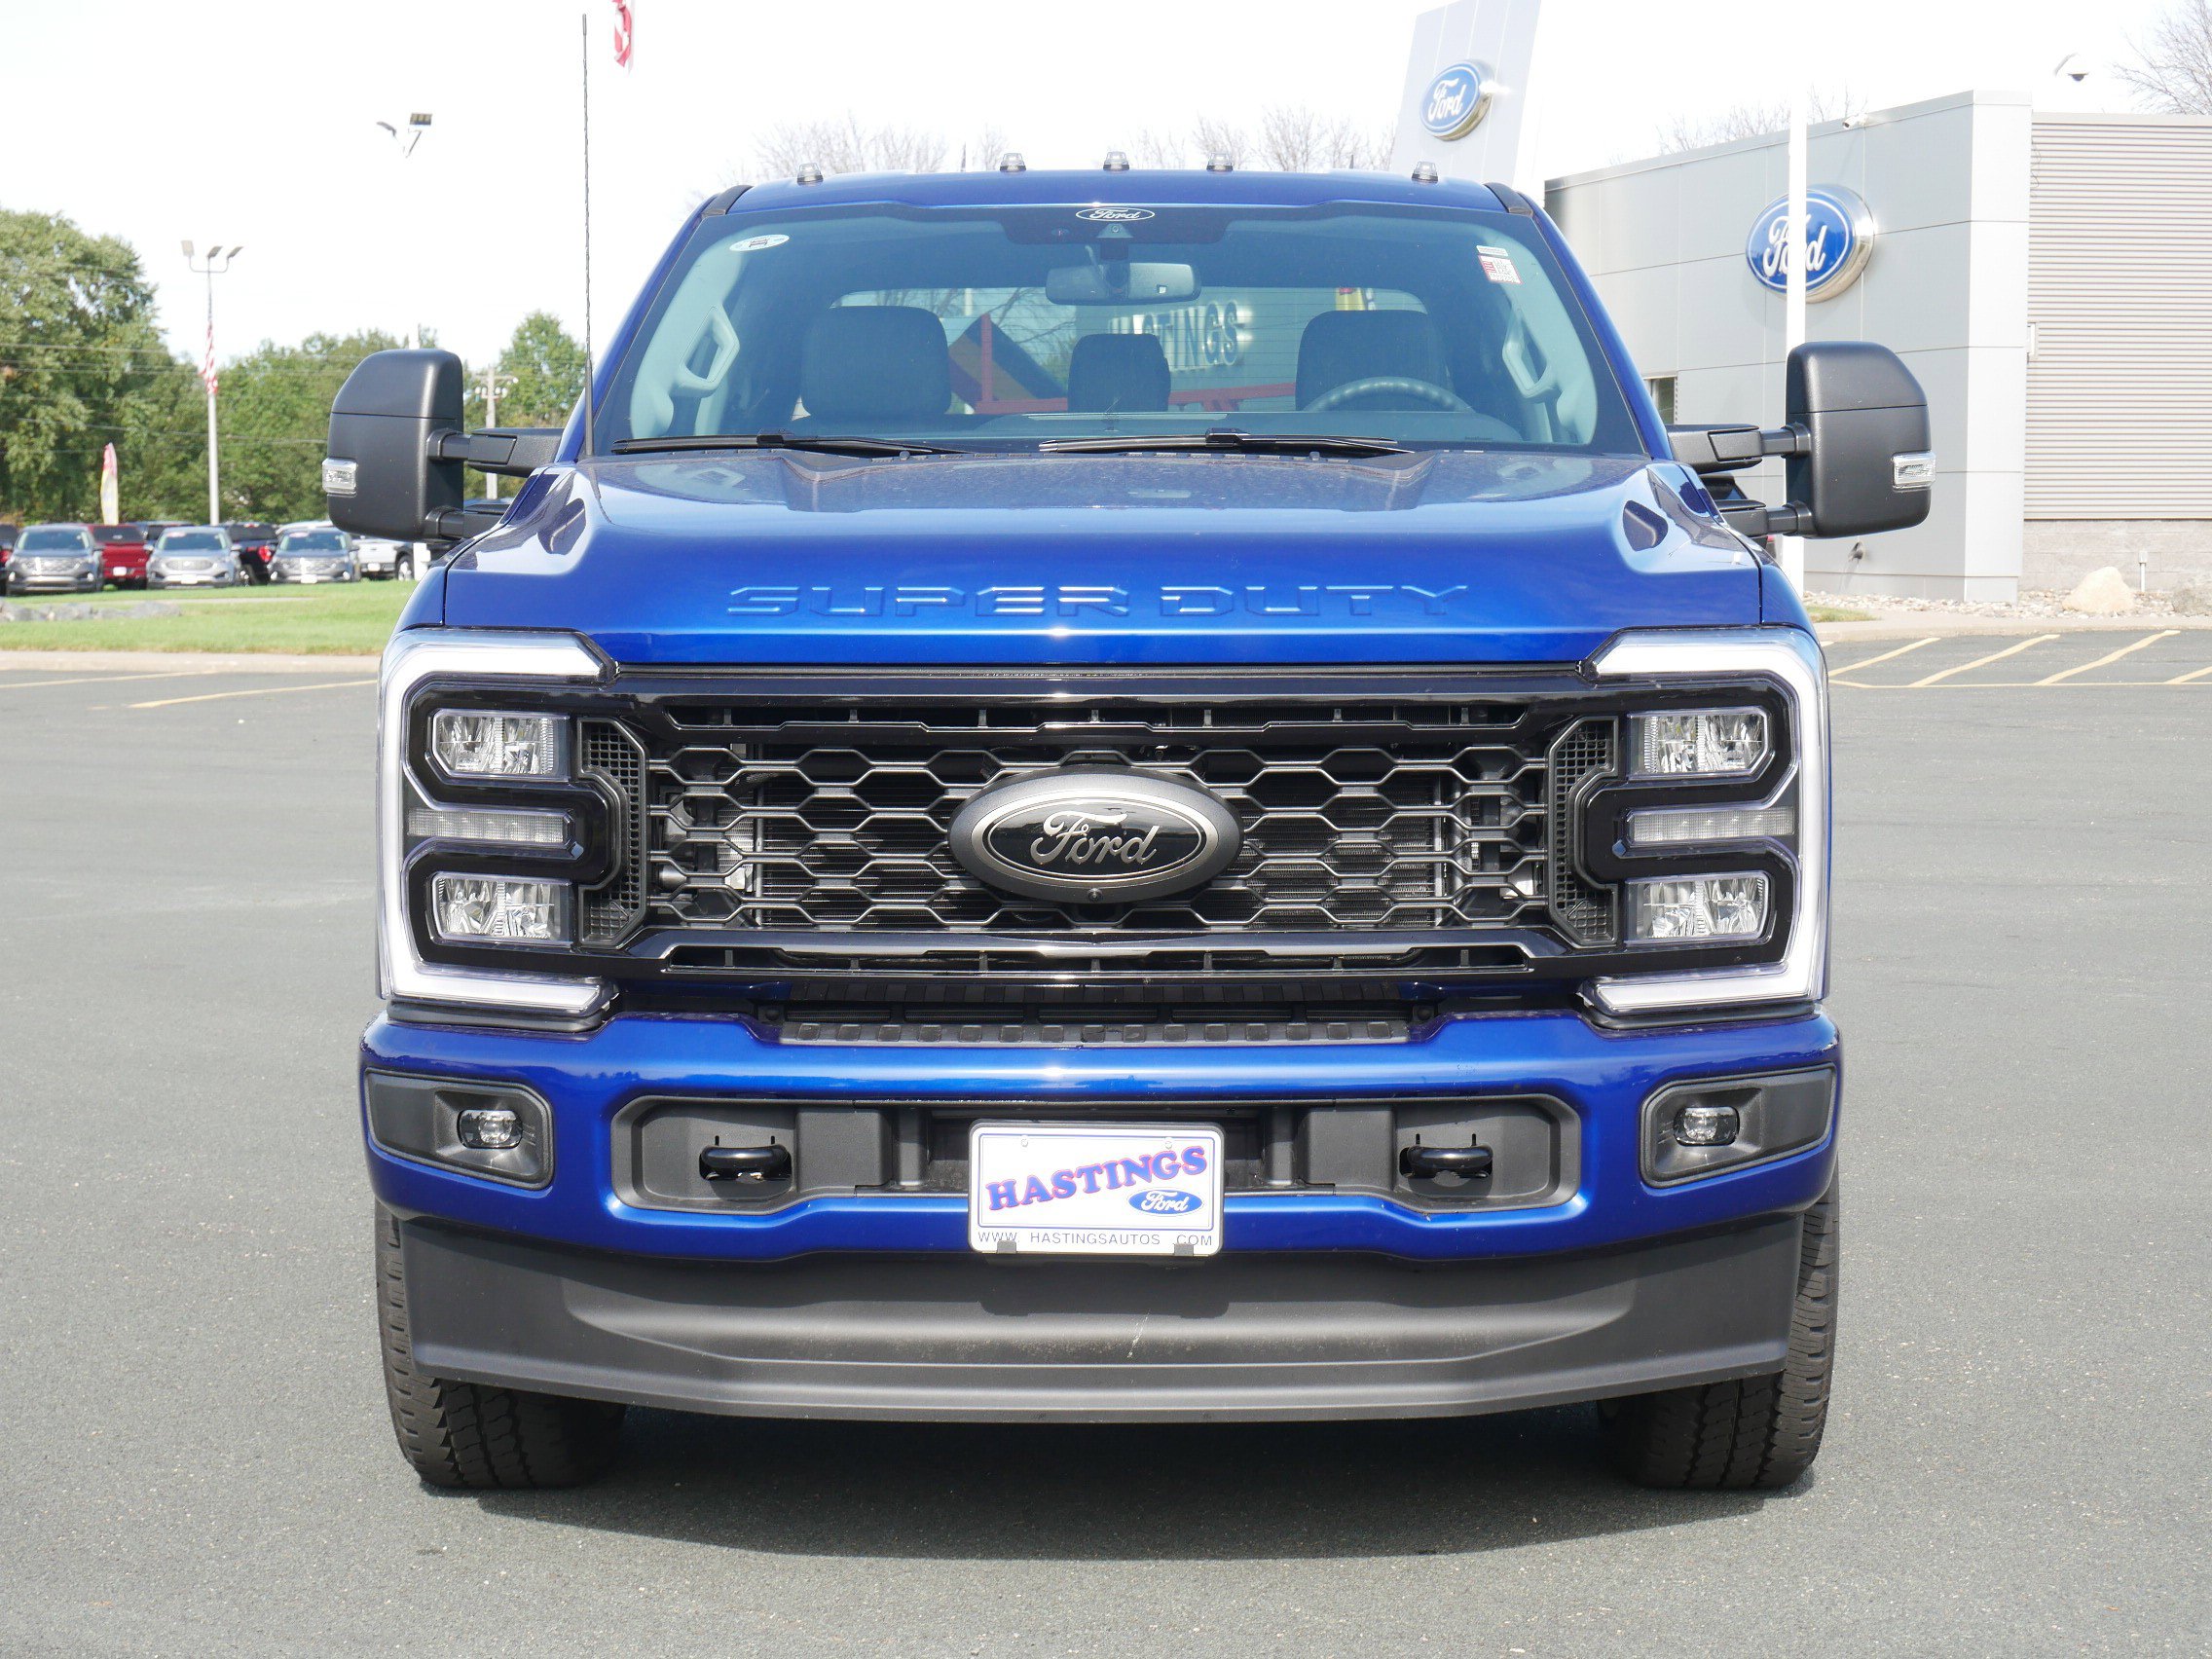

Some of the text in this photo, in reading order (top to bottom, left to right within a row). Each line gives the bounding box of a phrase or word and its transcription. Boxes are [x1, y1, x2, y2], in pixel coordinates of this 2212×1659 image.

[1427, 78, 1467, 122] Ford
[1089, 206, 1141, 219] Ford
[727, 585, 1468, 616] SUPER DUTY
[1030, 811, 1161, 865] Ford
[985, 1145, 1208, 1211] HASTINGS
[1141, 1190, 1190, 1211] Ford
[1030, 1232, 1161, 1245] HASTINGSAUTOS
